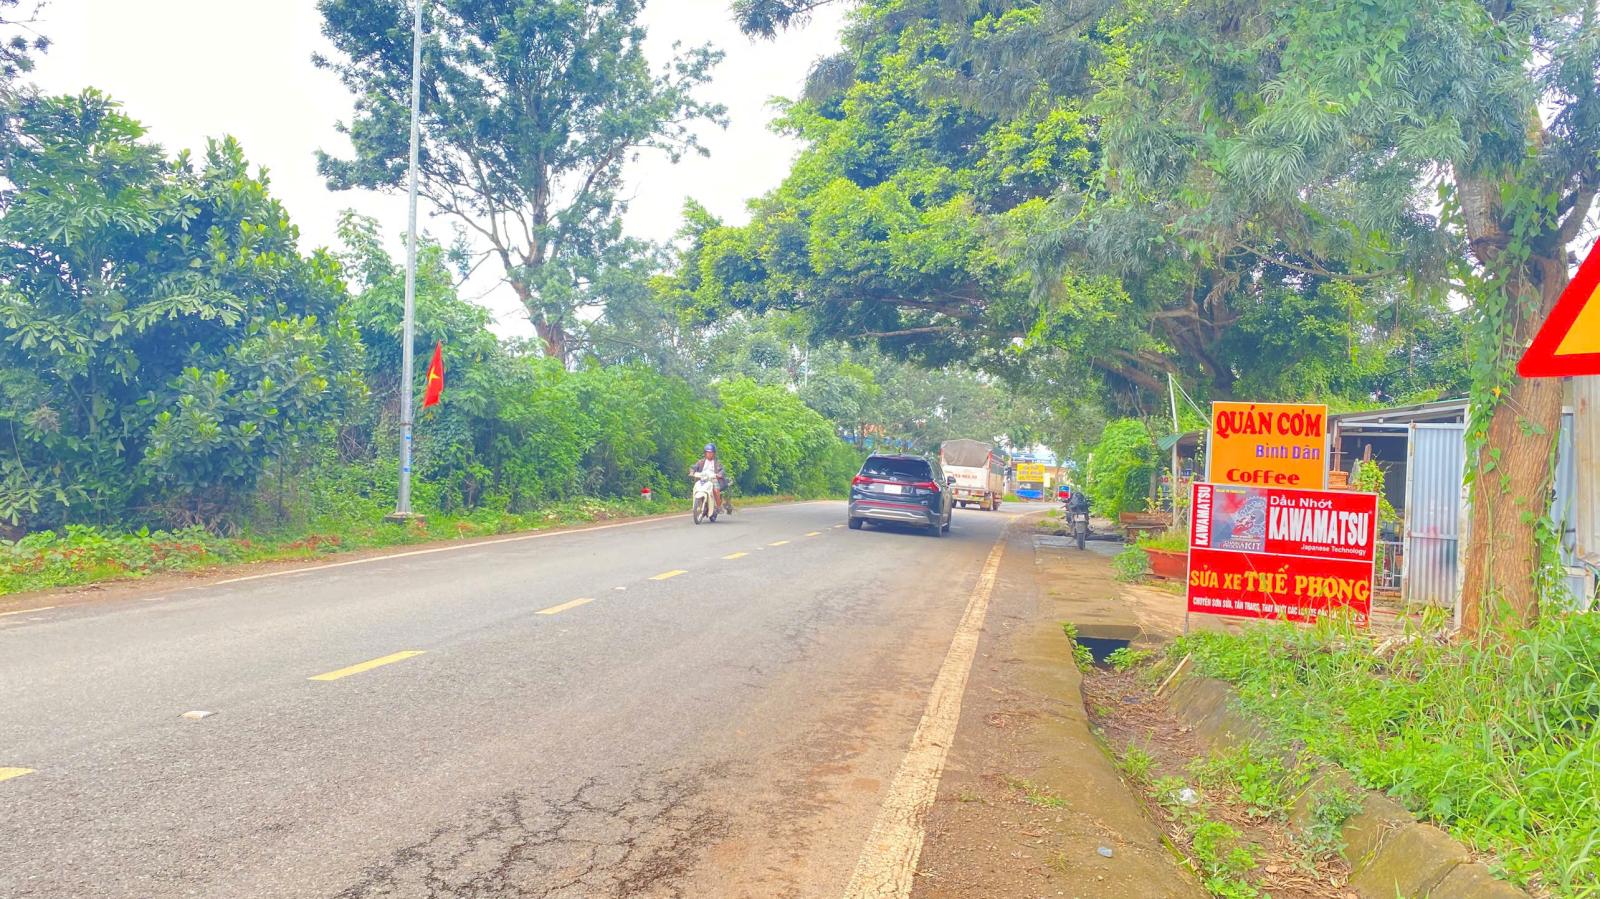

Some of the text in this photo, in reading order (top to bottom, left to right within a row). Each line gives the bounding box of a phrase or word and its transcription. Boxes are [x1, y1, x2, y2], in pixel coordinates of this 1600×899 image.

[1216, 405, 1322, 439] QUÁN CƠM
[1292, 444, 1320, 460] Dân
[1195, 486, 1211, 546] KAWAMATSU
[1270, 494, 1333, 509] Dầu Nhớt
[1268, 506, 1369, 547] KAWAMATSU
[1301, 544, 1366, 556] Japanese Technology
[1190, 564, 1371, 601] SỬA XE THẾ PHONG
